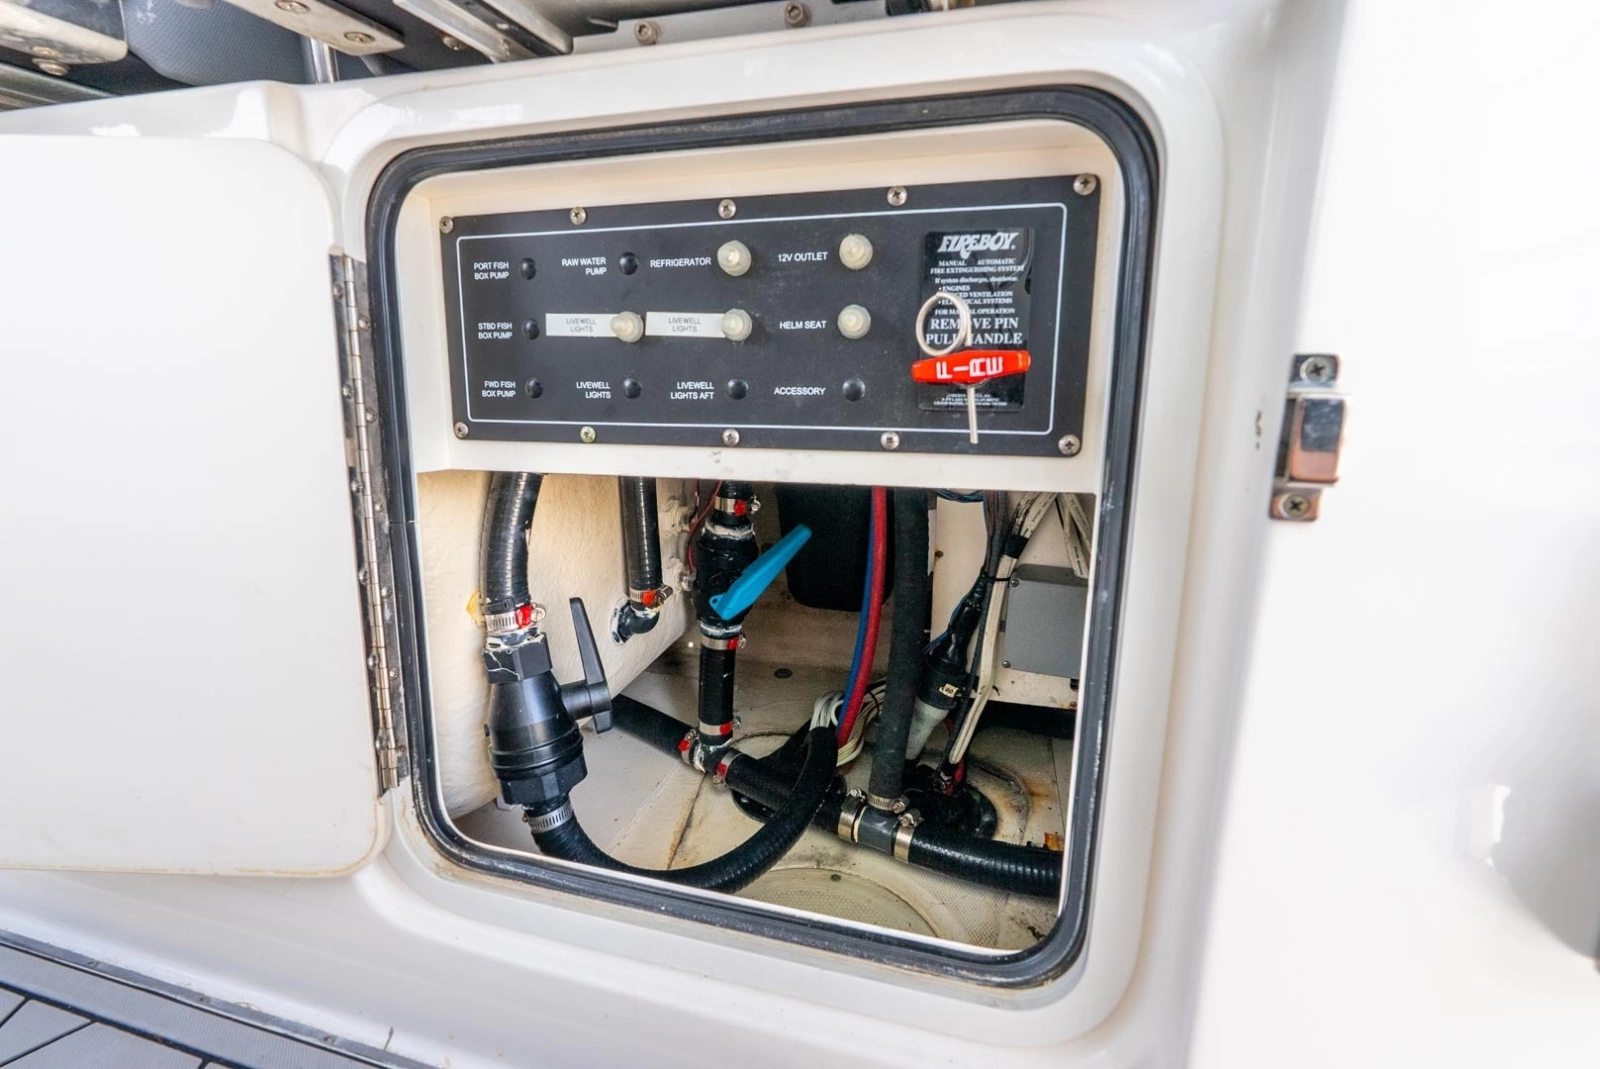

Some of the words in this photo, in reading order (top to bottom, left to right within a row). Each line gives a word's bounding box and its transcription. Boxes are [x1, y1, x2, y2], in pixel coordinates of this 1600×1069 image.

[777, 253, 793, 262] 12V
[795, 252, 828, 261] OUTLET
[473, 262, 492, 270] PORT
[493, 261, 510, 269] FISH
[561, 258, 578, 267] RAW
[579, 257, 606, 266] WATER
[650, 257, 711, 268] REFRIGERATOR
[585, 267, 607, 275] PUMP
[946, 266, 997, 274] EXTINGUISHING
[474, 272, 489, 280] BOX
[490, 271, 509, 280] PUMP
[977, 307, 1015, 315] OPERATION
[668, 317, 702, 325] LIVEWELL
[779, 321, 803, 329] HELM
[804, 320, 827, 329] SEAT
[930, 317, 991, 330] REMVE
[994, 317, 1019, 329] PIN
[478, 322, 496, 330] STBD
[496, 322, 512, 330] FISH
[672, 325, 697, 333] LIGHTS
[492, 331, 513, 339] PUMP
[484, 380, 500, 388] FWD
[576, 381, 611, 389] LIVEWELL
[677, 381, 714, 390] LIVEWELL
[482, 390, 495, 398] BOX
[495, 390, 516, 398] PUMP
[585, 391, 611, 399] LIGHTS
[670, 391, 698, 400] LIGHTS
[699, 391, 714, 399] AFT
[774, 387, 826, 396] ACCESSORY
